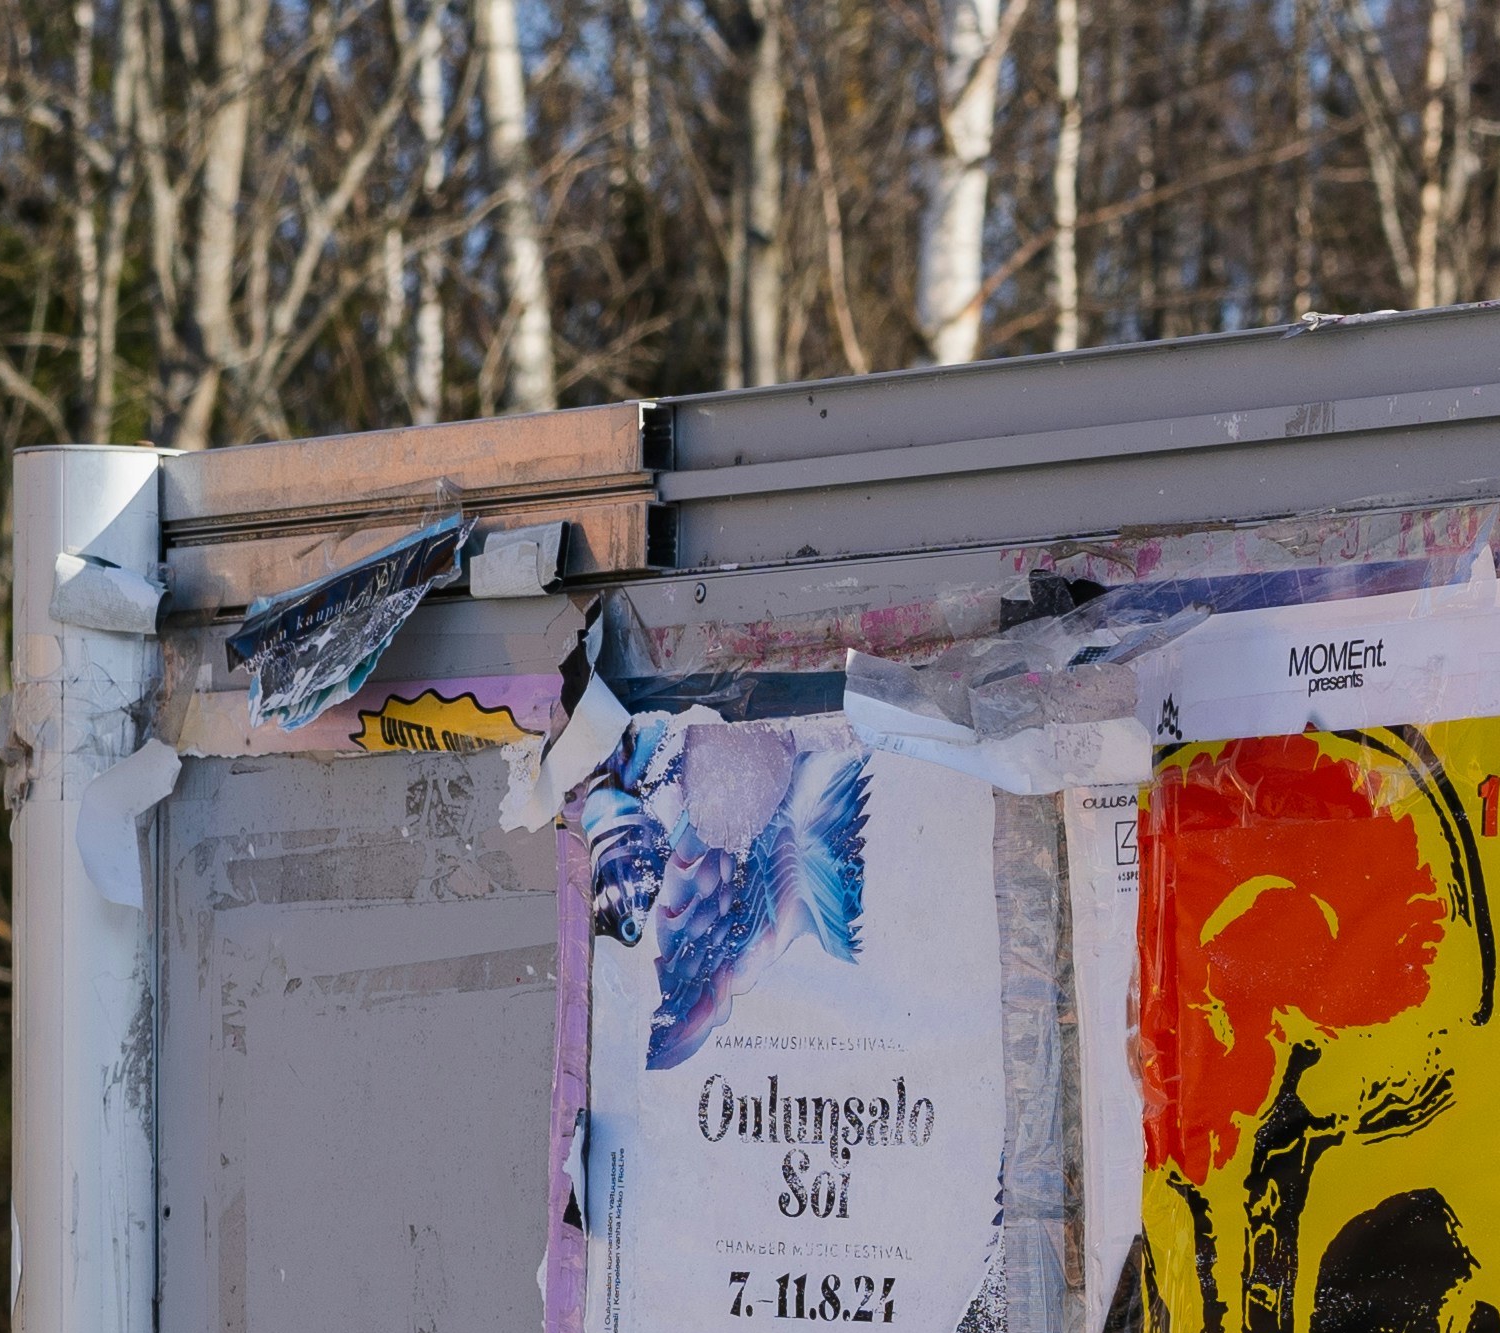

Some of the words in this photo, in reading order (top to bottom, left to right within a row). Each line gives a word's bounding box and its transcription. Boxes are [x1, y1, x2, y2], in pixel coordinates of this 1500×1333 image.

[1288, 639, 1388, 678] MOMEnt.
[1308, 671, 1364, 697] presents
[698, 1072, 935, 1160] Oulunsalo
[778, 1148, 851, 1219] Soi
